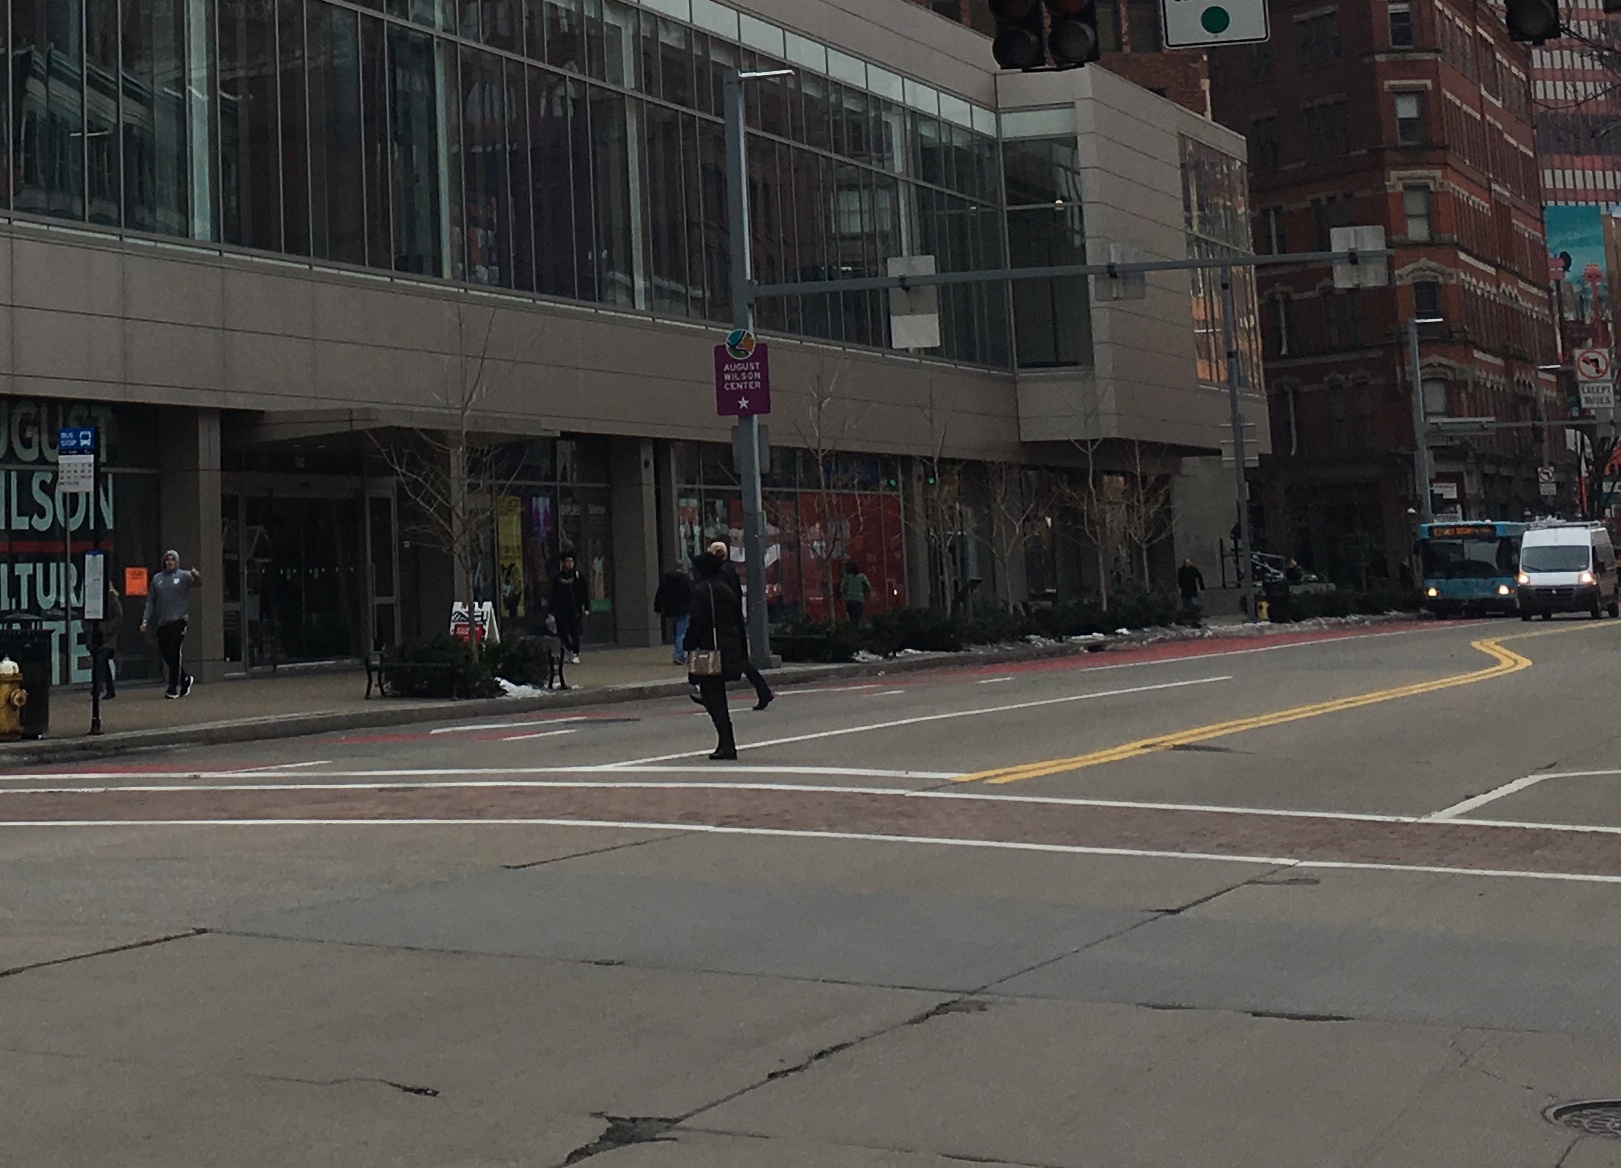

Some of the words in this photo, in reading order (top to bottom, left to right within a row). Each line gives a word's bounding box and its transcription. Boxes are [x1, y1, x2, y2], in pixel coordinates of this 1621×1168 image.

[723, 362, 760, 372] AUGUST
[723, 372, 761, 381] WILSON
[724, 381, 761, 391] CENTER
